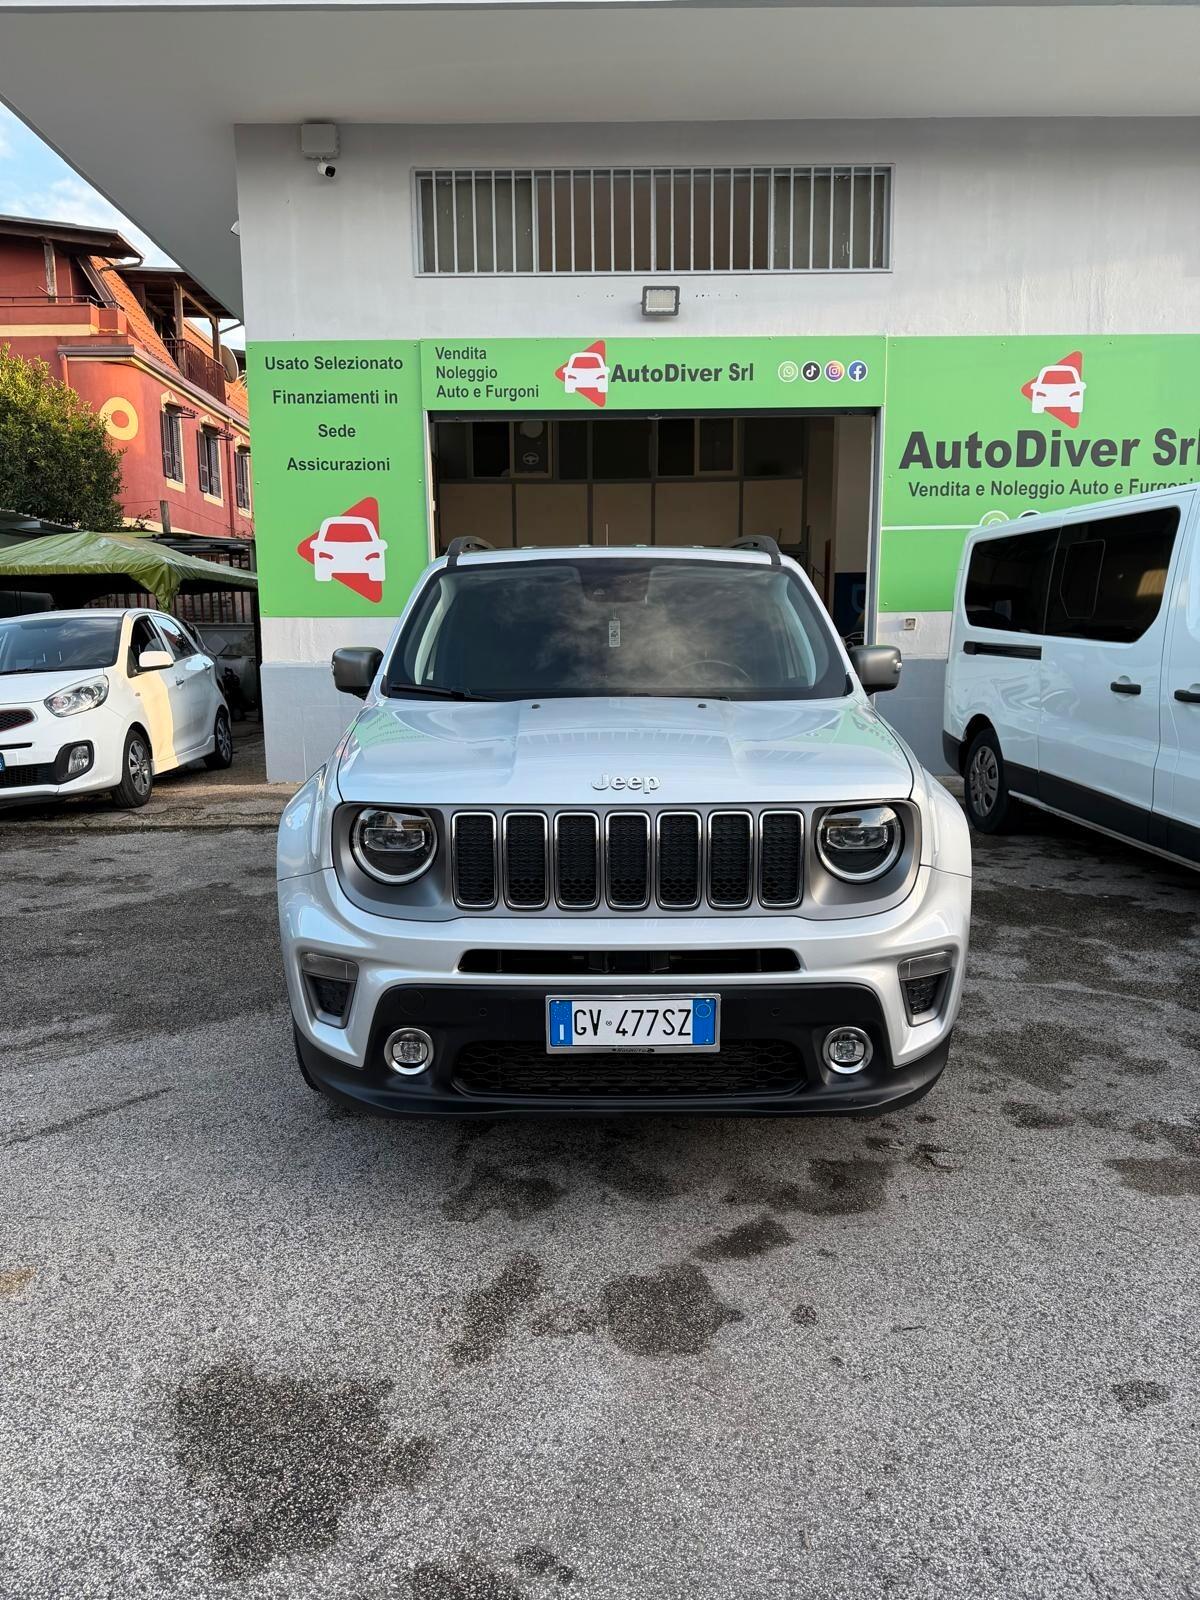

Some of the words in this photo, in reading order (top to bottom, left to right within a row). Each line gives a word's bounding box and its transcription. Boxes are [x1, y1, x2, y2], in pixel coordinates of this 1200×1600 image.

[434, 346, 487, 360] Vendita
[264, 356, 310, 371] Usato
[314, 355, 404, 370] Selezionato
[436, 365, 498, 383] Noleggio
[610, 363, 723, 383] AutoDiver
[728, 362, 754, 382] Srl
[272, 389, 379, 405] Finanziamenti
[384, 389, 398, 404] in
[436, 384, 469, 398] Auto
[473, 387, 481, 398] e
[485, 384, 539, 402] Furgoni
[318, 423, 356, 438] Sede
[899, 429, 1141, 470] AutoDiver
[286, 457, 390, 471] Assicurazioni
[908, 481, 970, 497] Vendita
[975, 484, 985, 496] e
[990, 480, 1065, 500] Noleggio
[1069, 479, 1109, 495] Auto
[1114, 483, 1124, 495] e
[1129, 478, 1194, 495] Furg
[591, 774, 661, 794] Jeep
